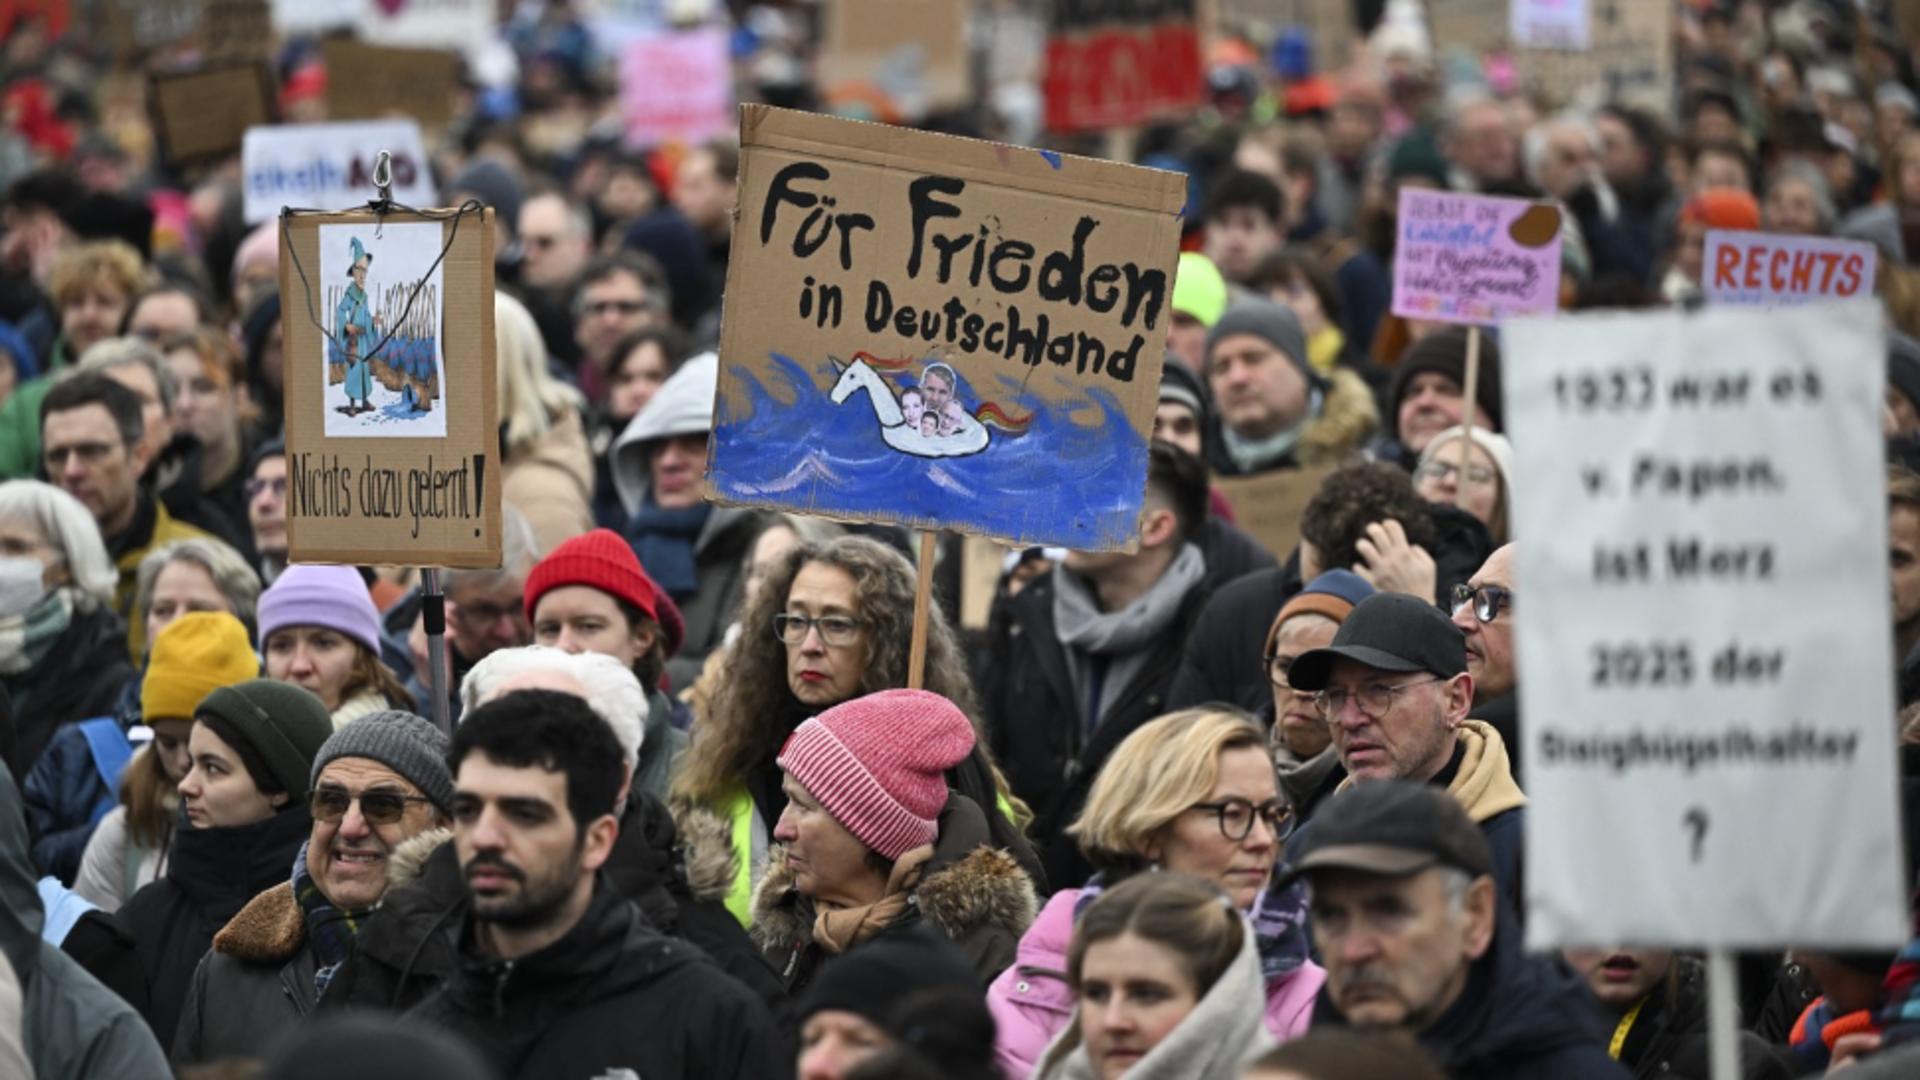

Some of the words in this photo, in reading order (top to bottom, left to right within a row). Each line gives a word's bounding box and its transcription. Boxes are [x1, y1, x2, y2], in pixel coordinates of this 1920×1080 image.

[253, 153, 417, 192] ekelhAD
[760, 161, 875, 271] Für
[907, 175, 1167, 330] Frieden
[1713, 243, 1865, 298] RECHTS
[799, 276, 842, 328] in
[865, 280, 1145, 382] Deutschland
[1553, 367, 1655, 408] 1933
[1668, 370, 1751, 407] war
[1769, 366, 1825, 402] es
[292, 453, 351, 518] Nichts
[359, 454, 402, 519] dazu
[408, 453, 486, 539] gelernt!
[1592, 540, 1651, 582] ist
[1666, 534, 1776, 584] Merz
[1591, 638, 1697, 689] 2025
[1710, 640, 1785, 687] der
[1539, 724, 1859, 776] Steigbügelhalter
[1681, 804, 1711, 864] ?
